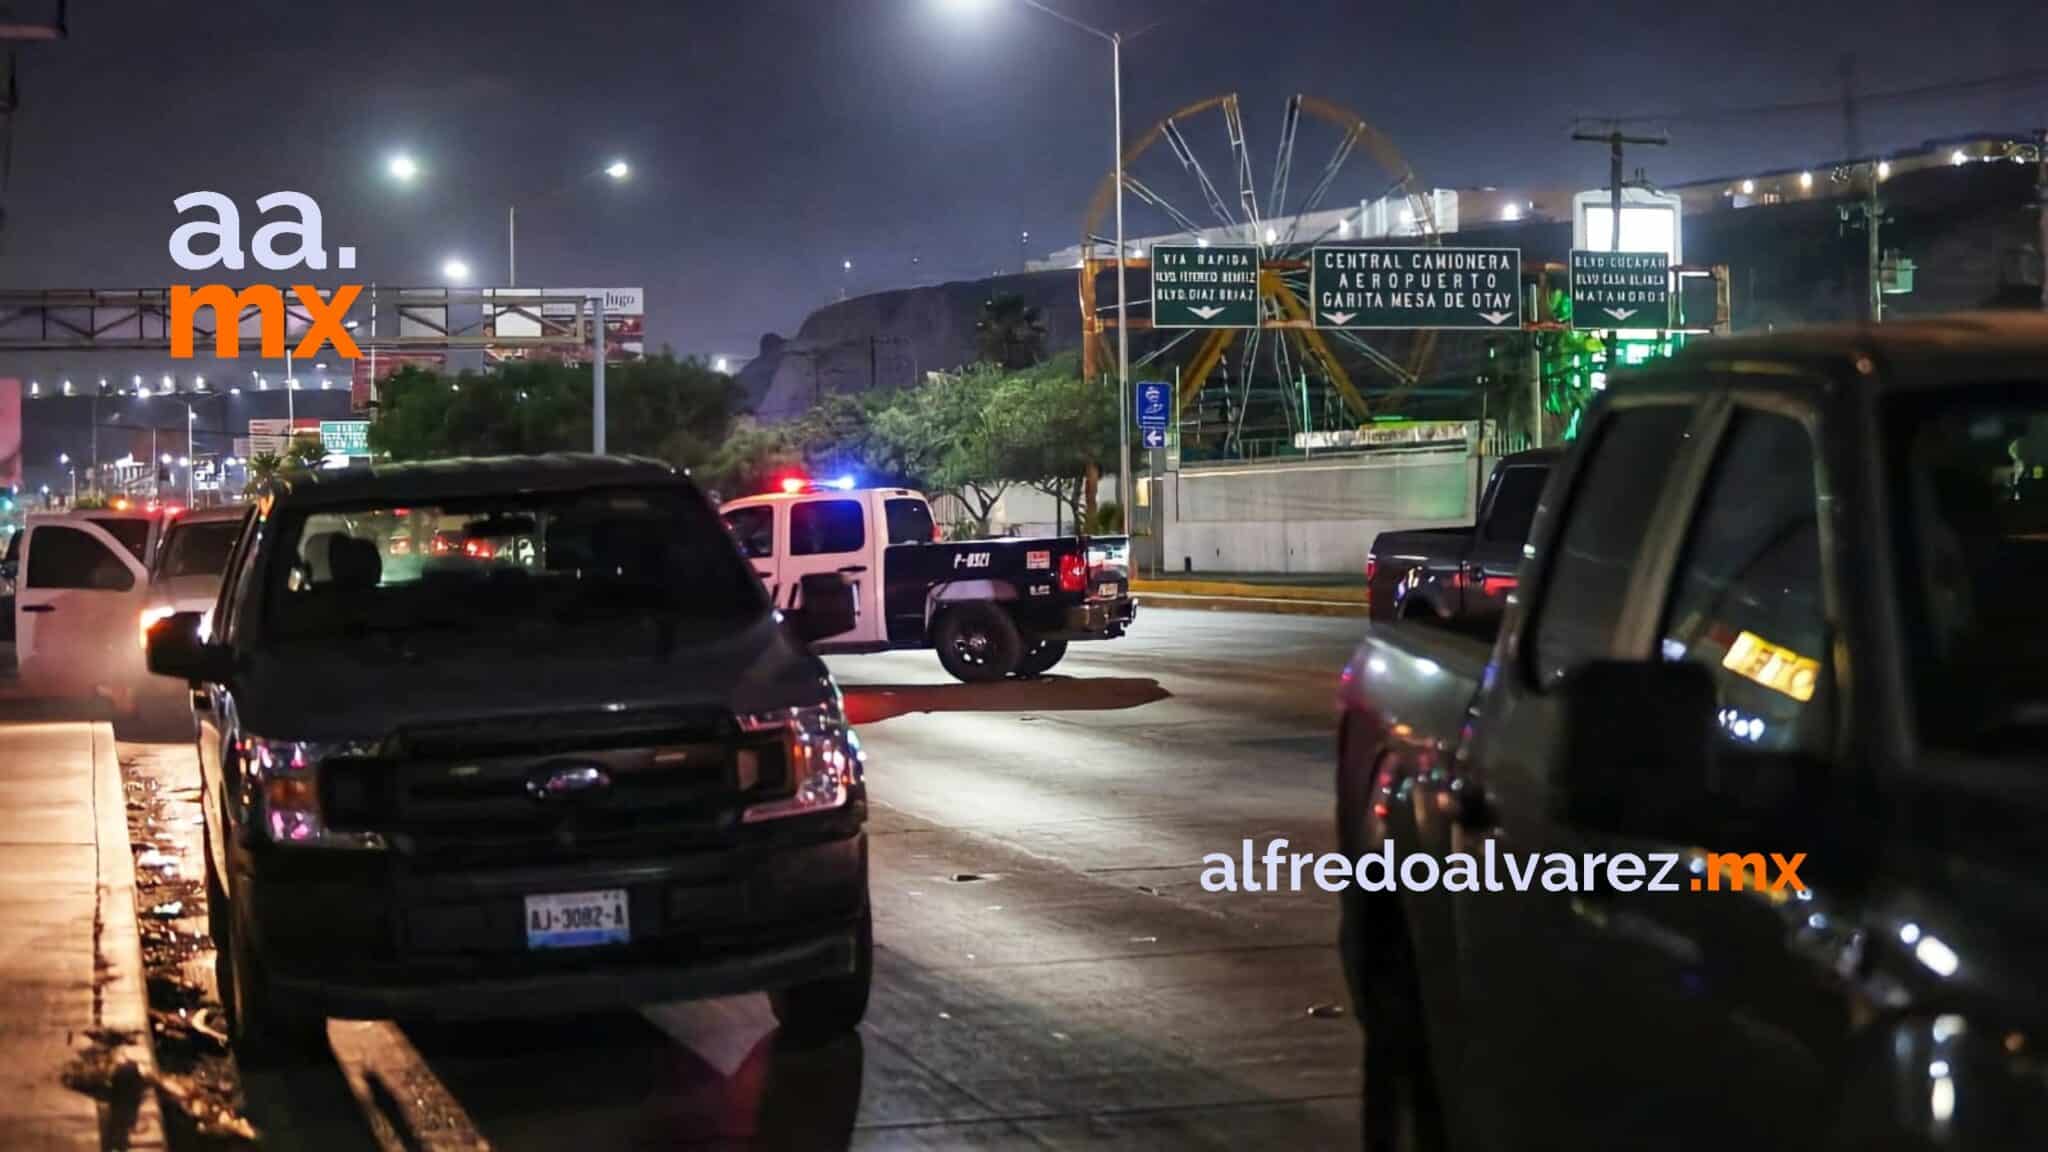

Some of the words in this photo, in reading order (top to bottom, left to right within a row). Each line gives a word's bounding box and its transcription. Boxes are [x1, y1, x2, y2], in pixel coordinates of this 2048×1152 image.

[1163, 253, 1186, 265] VIA
[1197, 253, 1248, 266] RAPIDA
[1325, 253, 1402, 269] CENTRAL
[1412, 254, 1511, 270] CAMIONERA
[1339, 273, 1497, 289] AEROPUERTO
[1188, 288, 1215, 301] DIAZ
[1322, 292, 1384, 308] GARITA
[1391, 292, 1436, 308] MESA
[1444, 292, 1465, 308] DE
[1471, 292, 1512, 309] OTAY
[1575, 289, 1665, 302] MATAMOROS
